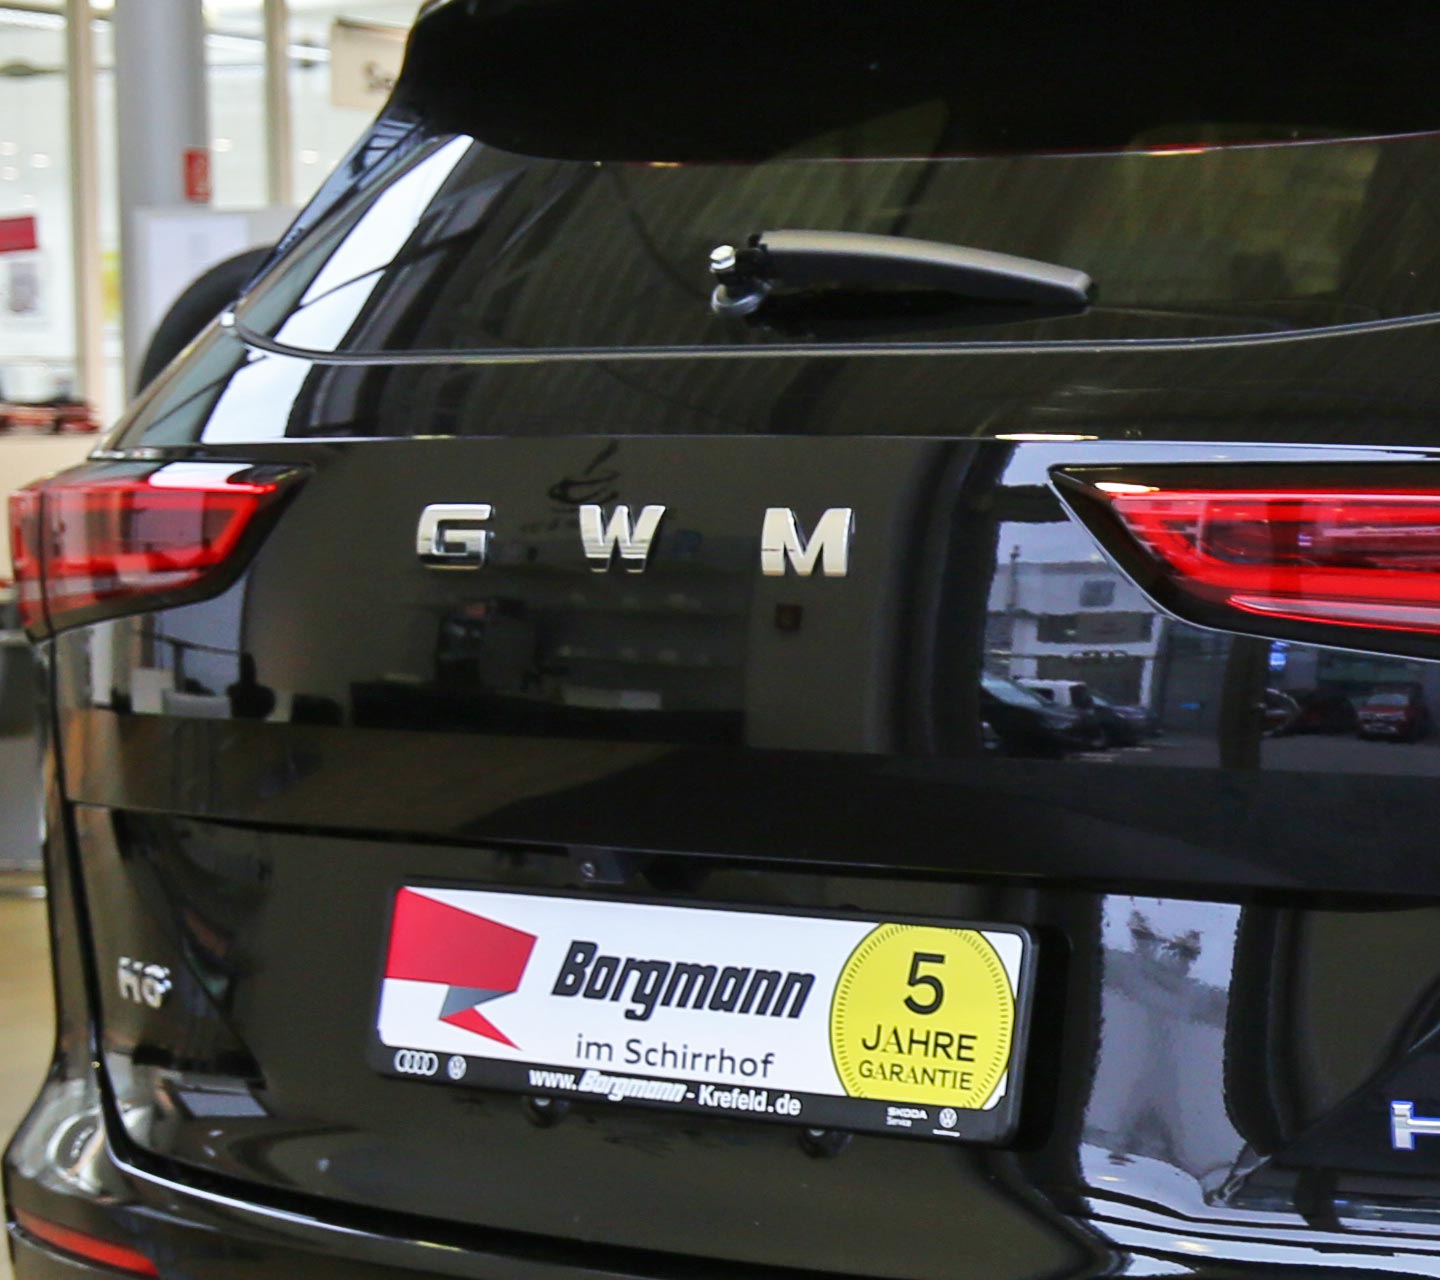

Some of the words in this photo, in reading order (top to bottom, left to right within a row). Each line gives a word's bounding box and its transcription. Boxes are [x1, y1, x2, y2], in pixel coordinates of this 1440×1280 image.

[417, 503, 855, 577] GWM
[551, 940, 816, 1021] Borgmann
[904, 951, 945, 1015] 5
[576, 1034, 613, 1062] im
[624, 1039, 775, 1078] Schirrhof
[862, 1024, 978, 1062] JAHRE
[858, 1060, 973, 1090] GARANTIE
